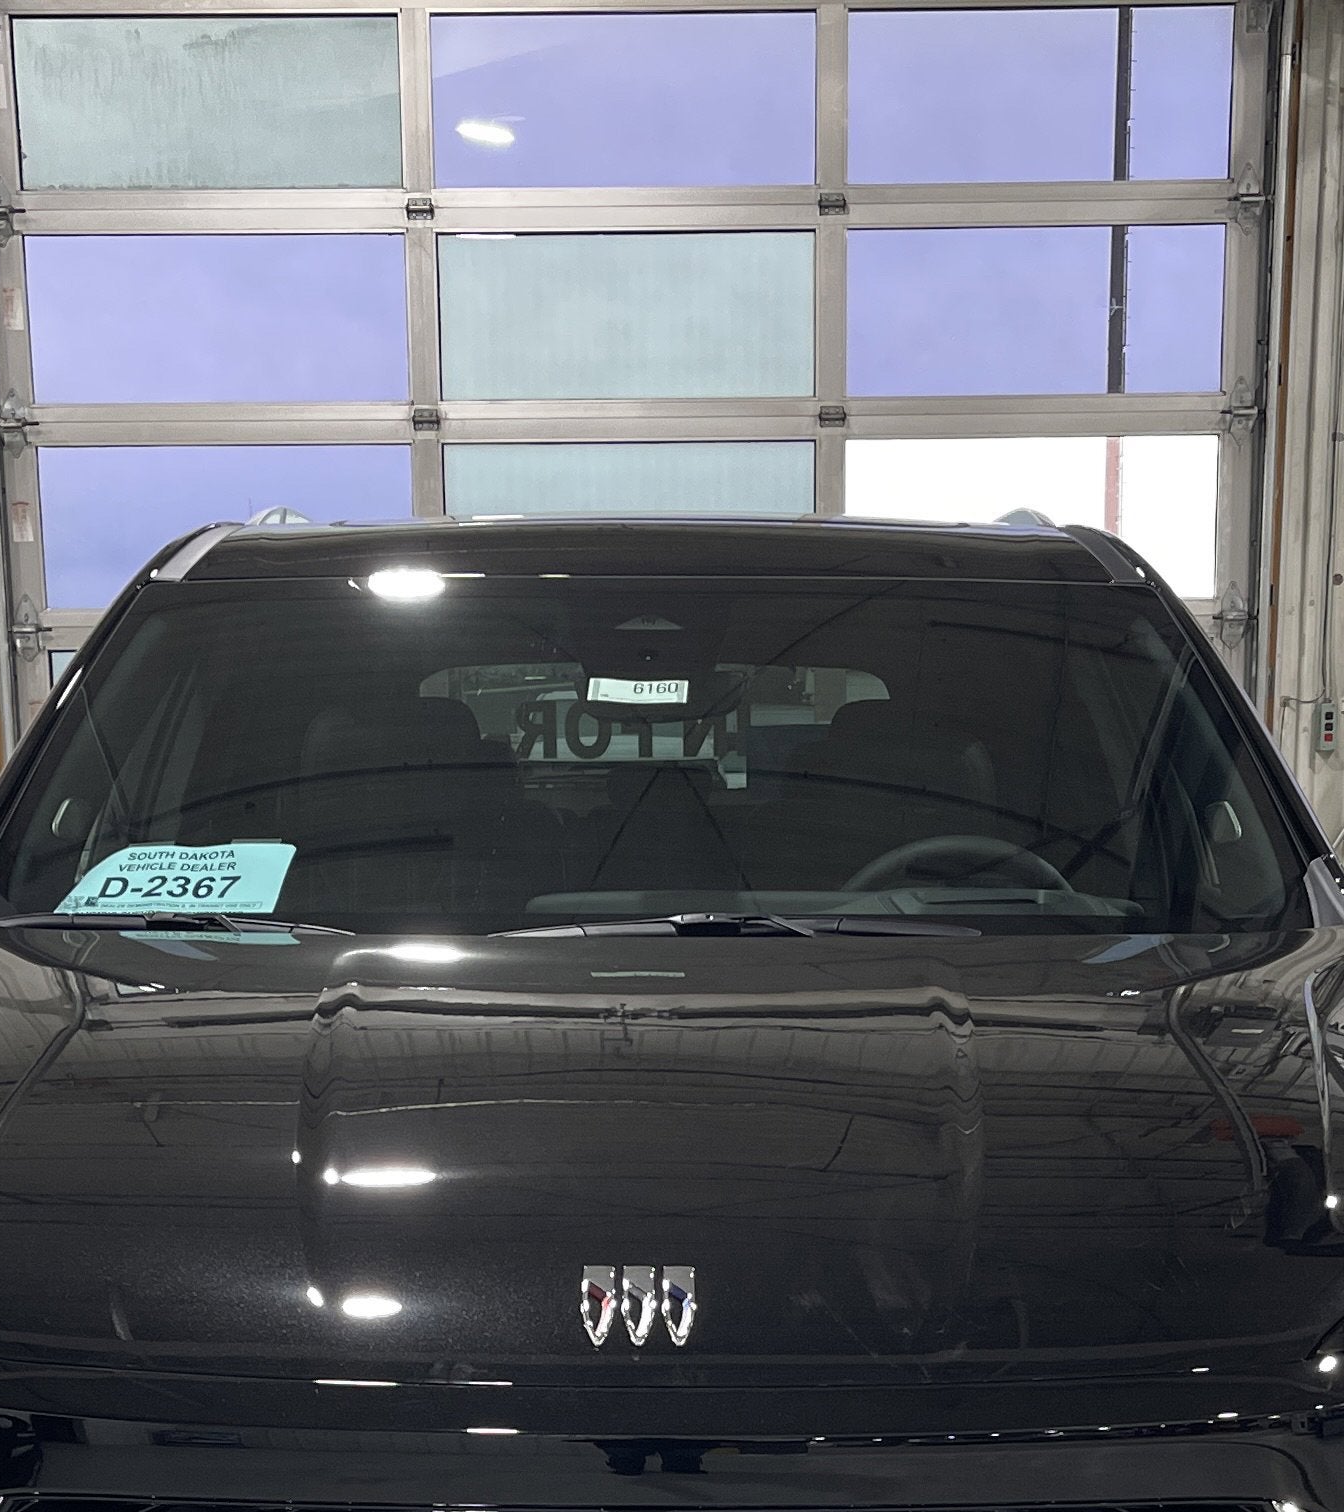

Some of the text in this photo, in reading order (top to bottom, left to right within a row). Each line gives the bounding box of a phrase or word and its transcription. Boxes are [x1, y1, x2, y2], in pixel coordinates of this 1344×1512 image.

[633, 682, 679, 695] 6160
[127, 850, 236, 861] SOUTH DAKOTA
[118, 861, 237, 872] VEHICLE DEALER
[98, 875, 242, 899] D-2367
